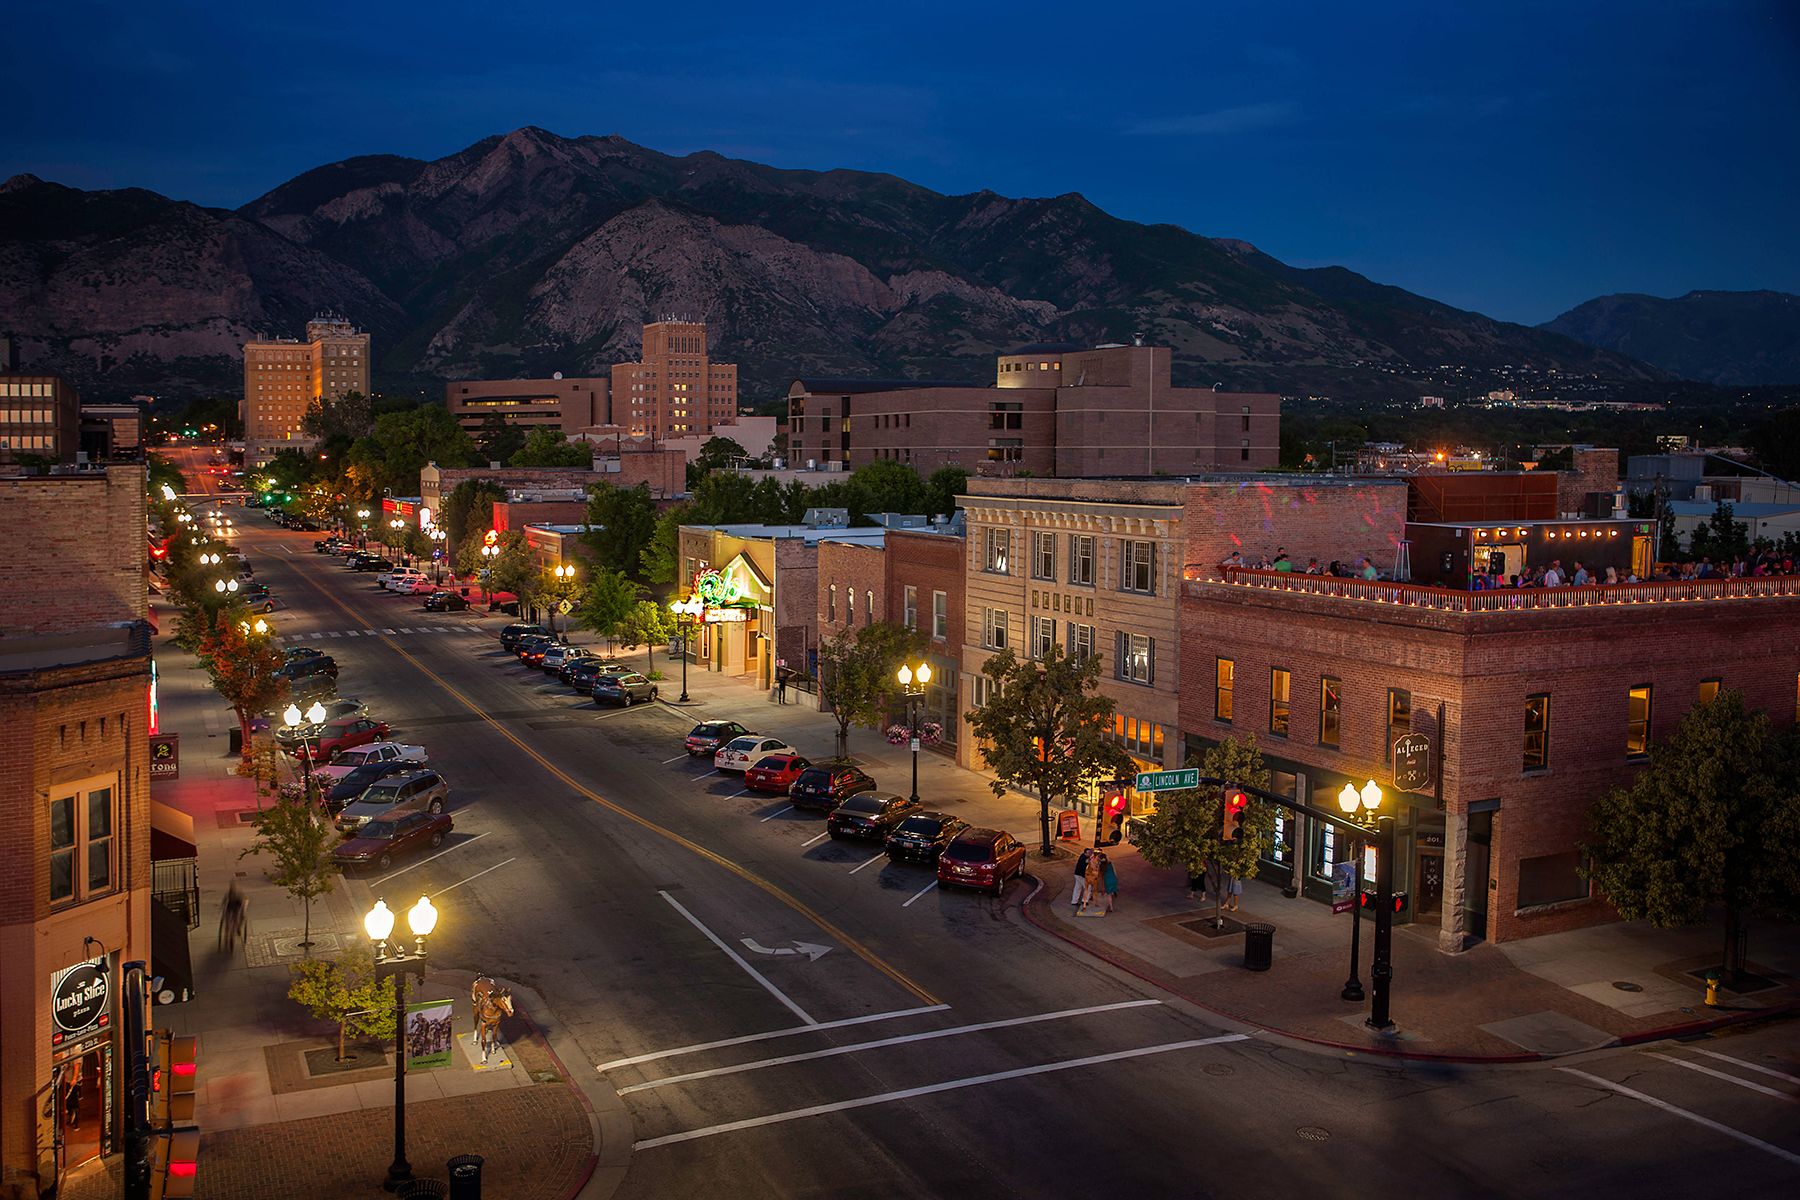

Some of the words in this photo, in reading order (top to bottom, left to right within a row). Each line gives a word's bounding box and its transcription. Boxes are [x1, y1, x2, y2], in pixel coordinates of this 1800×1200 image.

[1033, 590, 1093, 617] HELENA
[151, 763, 177, 771] tona
[1155, 774, 1179, 786] LINCOLN
[57, 992, 83, 1012] Lucky
[84, 984, 105, 1001] Slice
[73, 1006, 90, 1018] pizza
